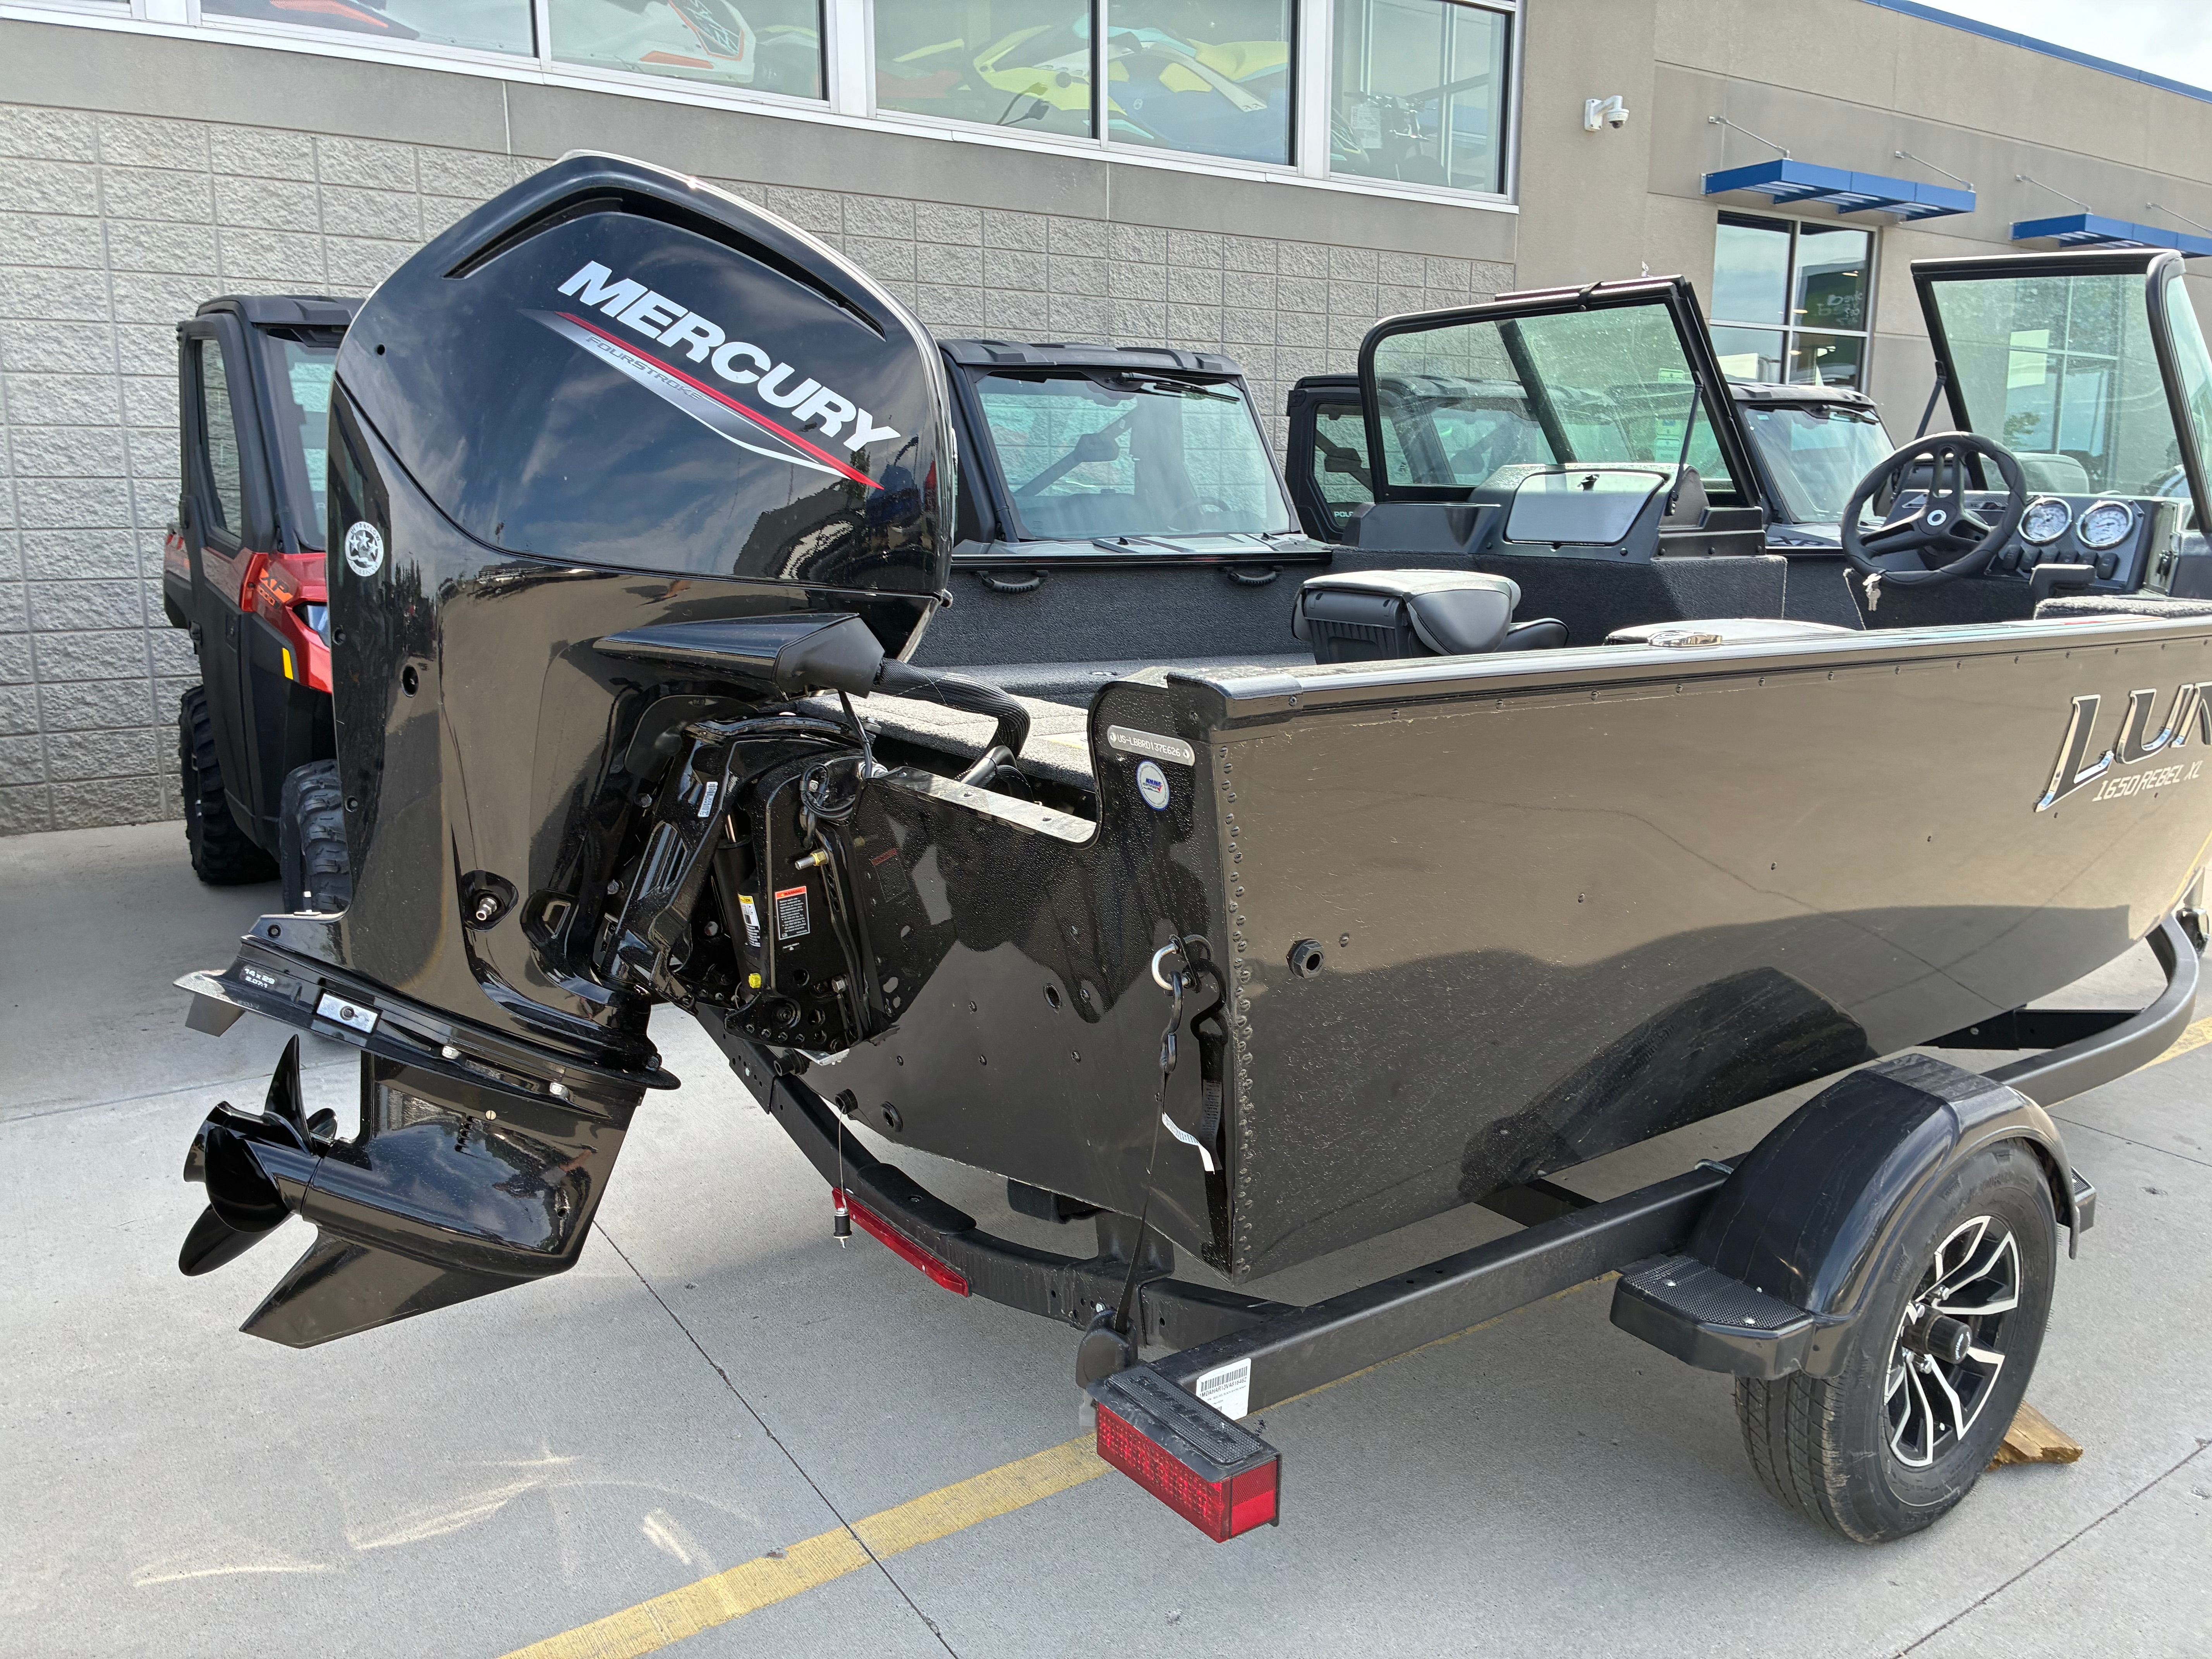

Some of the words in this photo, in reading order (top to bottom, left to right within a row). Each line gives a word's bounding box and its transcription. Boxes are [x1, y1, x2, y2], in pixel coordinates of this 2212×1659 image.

[557, 260, 902, 452] MERCURY
[585, 334, 704, 401] FOURSTROKE
[261, 570, 289, 593] XP
[1117, 734, 1181, 757] US-LBBRD137E626
[2092, 774, 2141, 802] 1650
[2133, 764, 2185, 797] REBEL
[2184, 760, 2204, 781] XL
[244, 968, 256, 977] 14
[261, 975, 275, 984] 29
